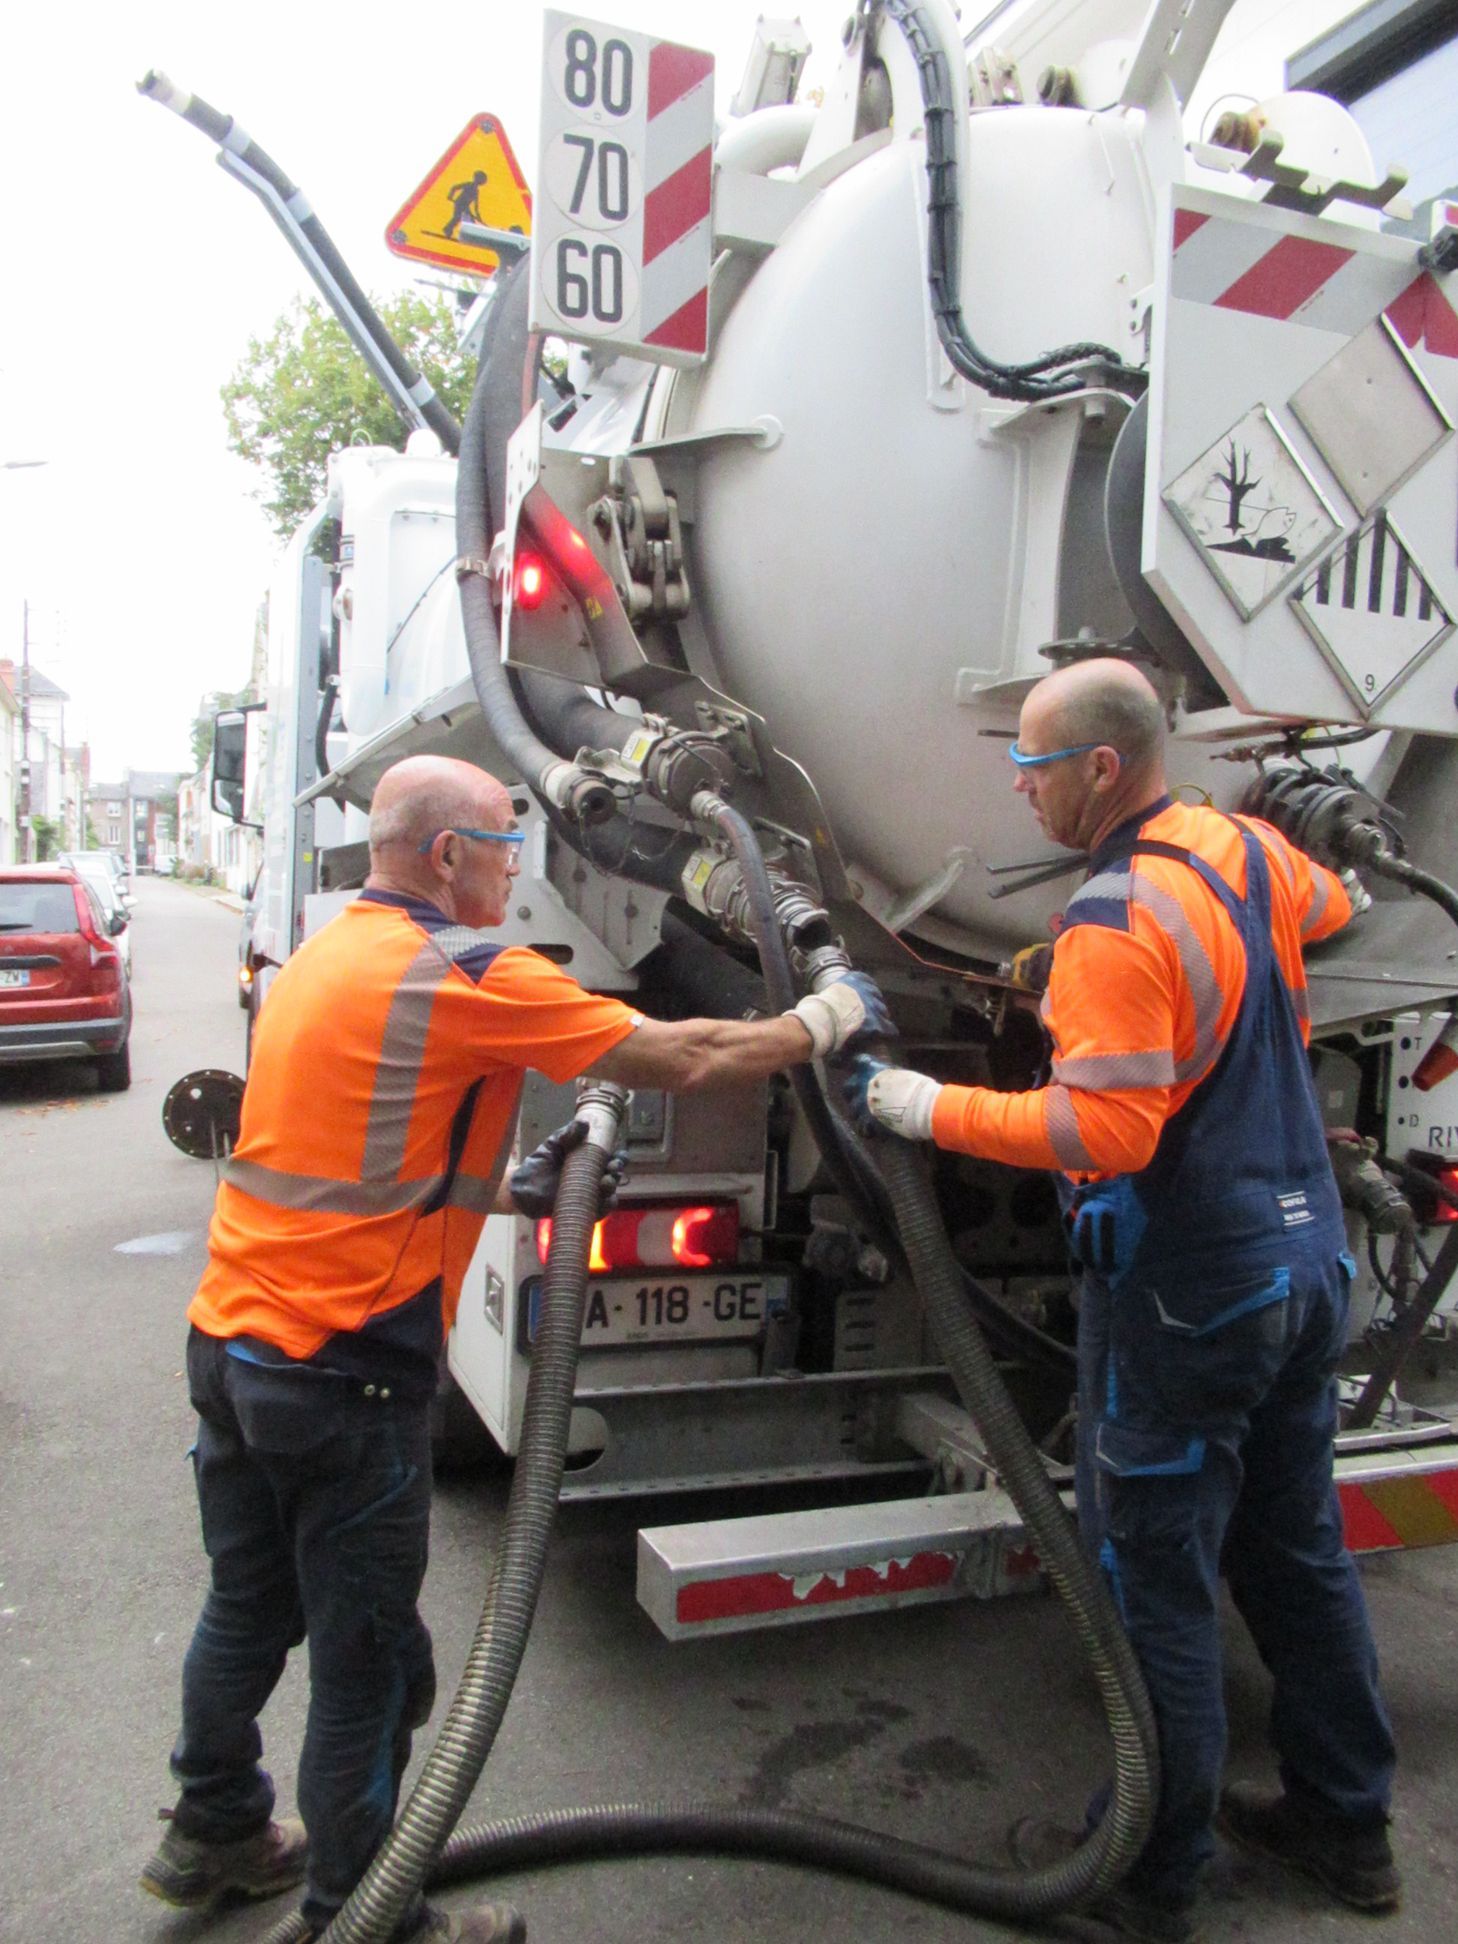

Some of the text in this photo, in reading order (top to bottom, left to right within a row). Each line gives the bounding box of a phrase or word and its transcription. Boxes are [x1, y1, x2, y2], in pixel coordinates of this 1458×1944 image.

[564, 28, 633, 117] 80
[563, 133, 629, 222] 70
[557, 238, 622, 323] 60
[1365, 674, 1375, 692] 9
